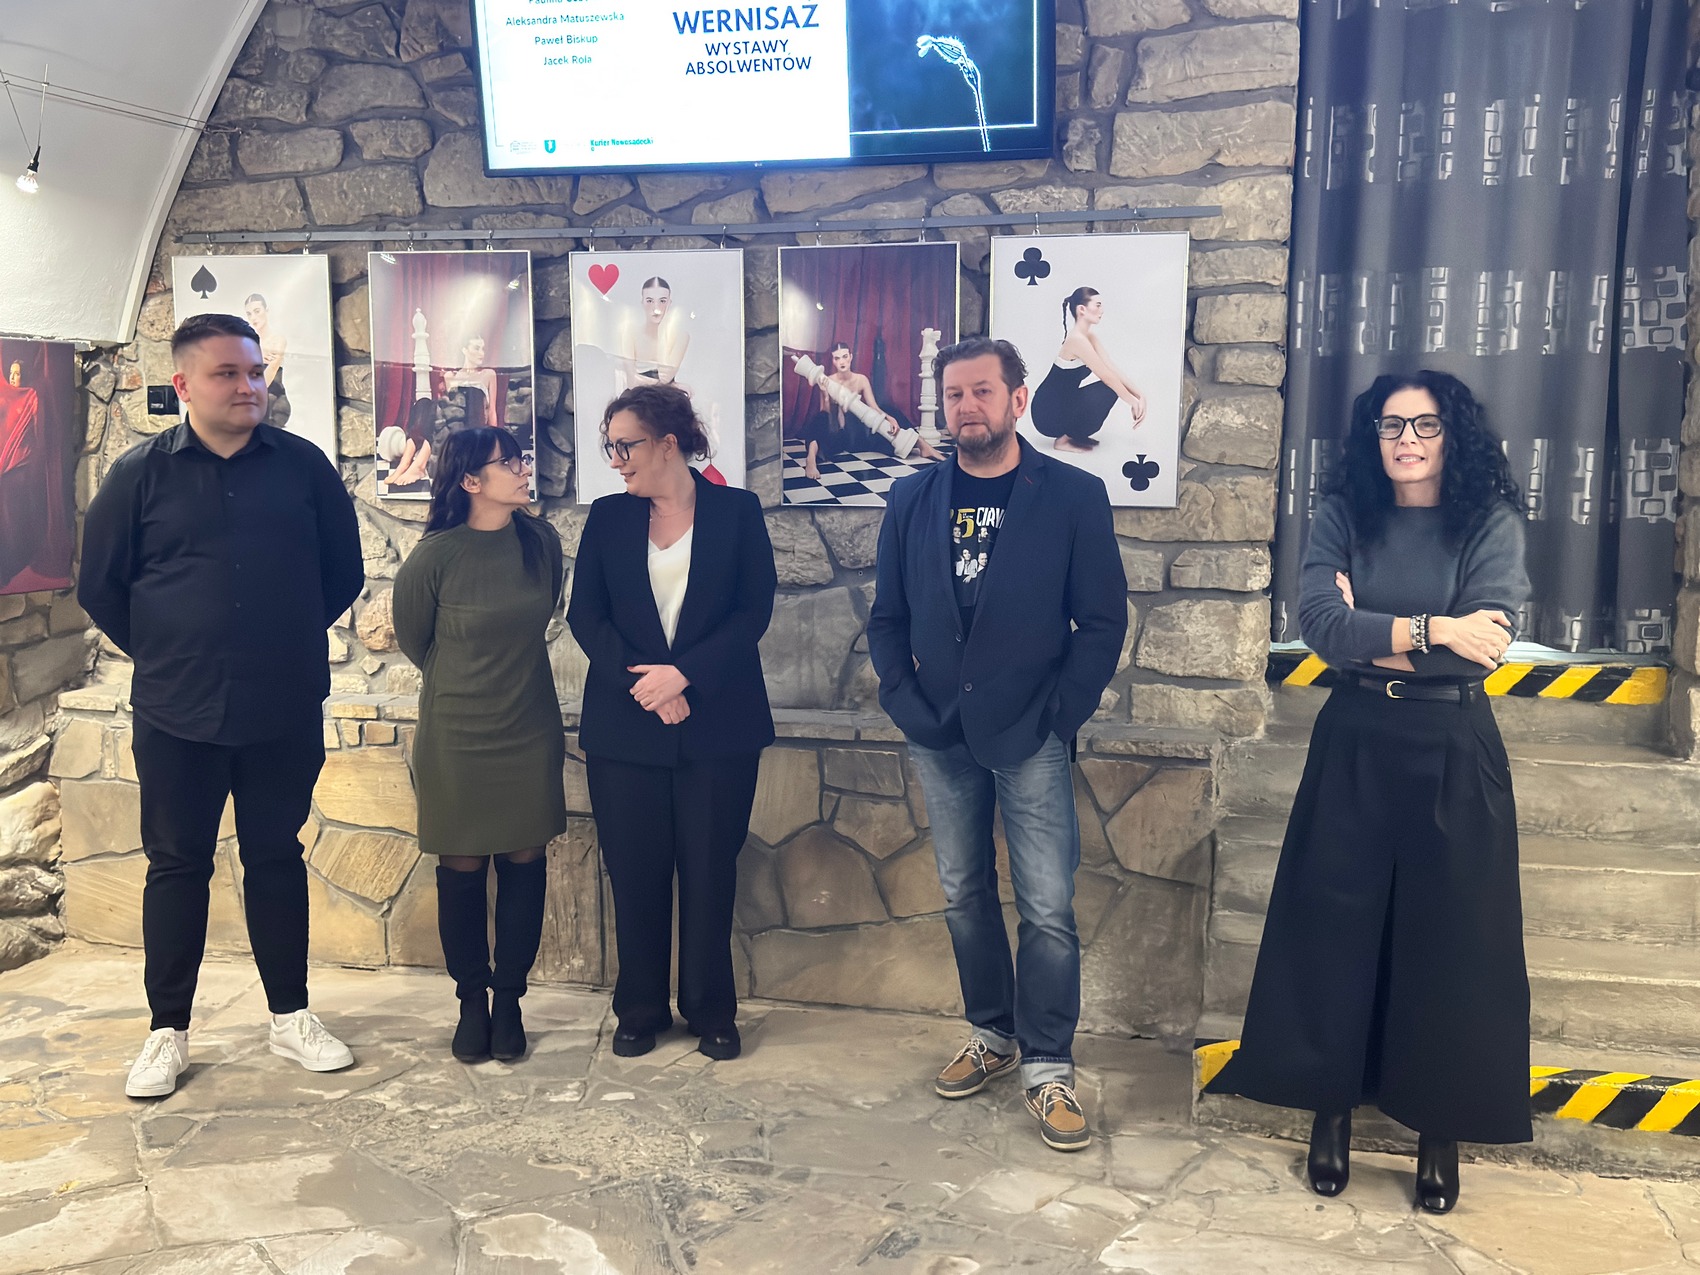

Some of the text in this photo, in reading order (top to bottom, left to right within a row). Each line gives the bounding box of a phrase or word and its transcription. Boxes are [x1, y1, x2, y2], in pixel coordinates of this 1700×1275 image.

[505, 11, 625, 26] Aleksandra Matuszewska
[534, 34, 599, 45] Paweł Biskup
[705, 39, 789, 56] WYSTAWY
[543, 54, 593, 66] Jacek Rola
[685, 52, 812, 75] ABSOLWENTÓW
[590, 139, 610, 147] Kurier
